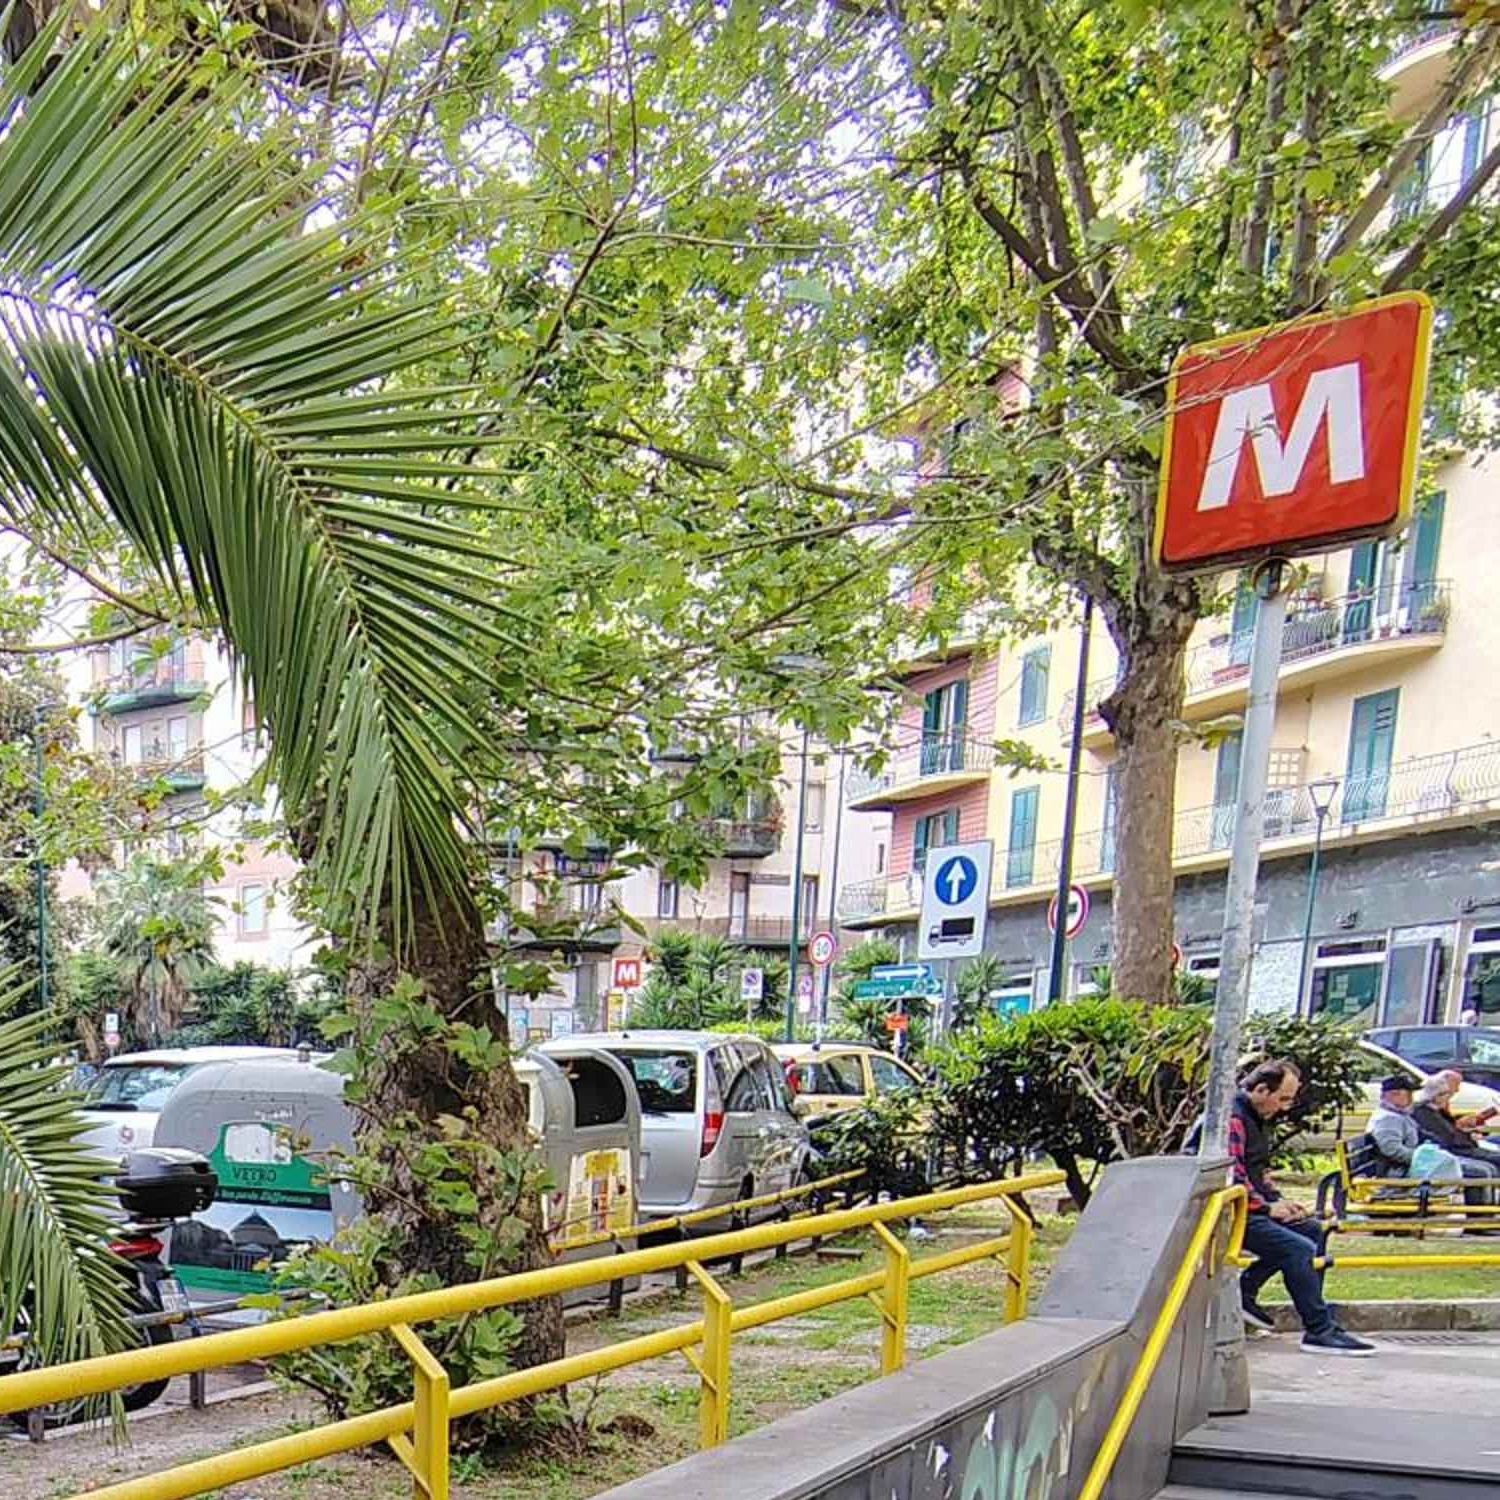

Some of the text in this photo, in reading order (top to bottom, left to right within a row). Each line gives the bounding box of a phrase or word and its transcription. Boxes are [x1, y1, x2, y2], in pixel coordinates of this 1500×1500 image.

[1197, 361, 1365, 511] M
[617, 963, 637, 983] M
[233, 1167, 277, 1183] VETRO
